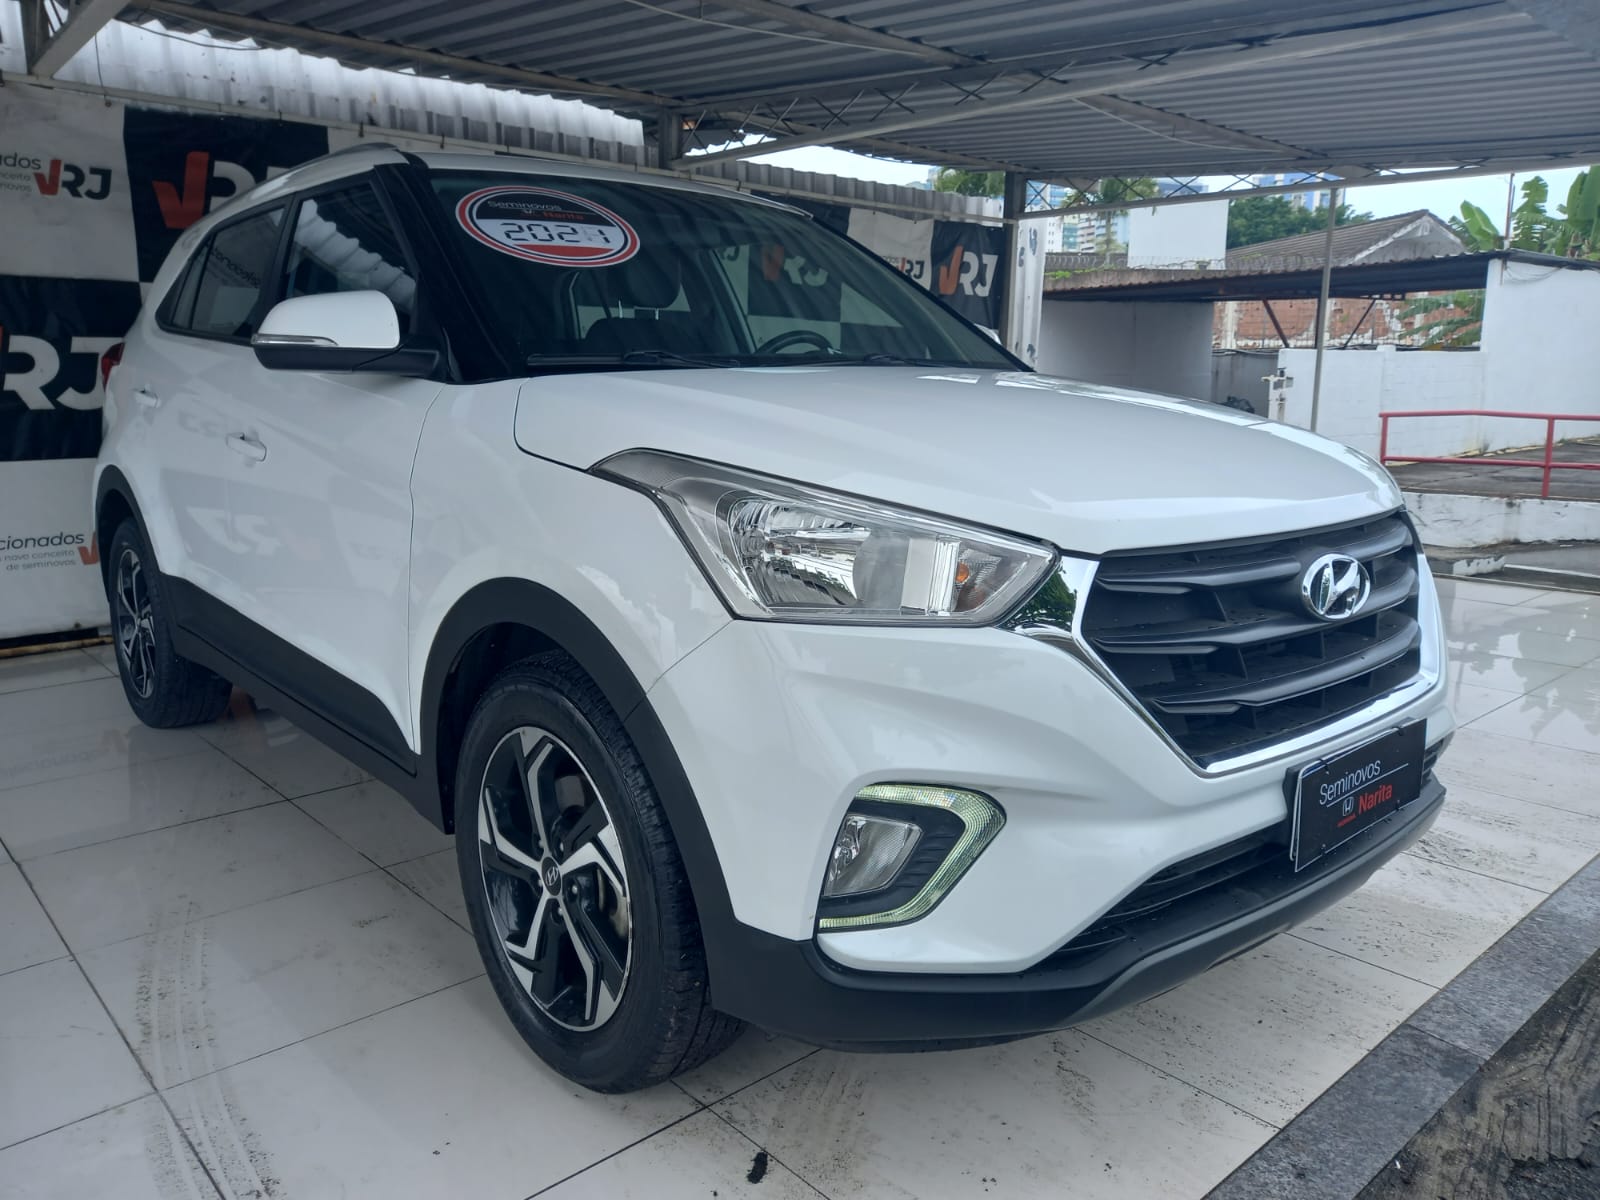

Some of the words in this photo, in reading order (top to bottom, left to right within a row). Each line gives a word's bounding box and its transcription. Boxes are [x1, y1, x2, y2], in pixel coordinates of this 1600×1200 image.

[0, 152, 41, 170] dos
[938, 245, 998, 297] VRJ
[0, 333, 119, 410] RJ
[6, 563, 19, 571] de
[22, 559, 77, 570] seminovos
[31, 550, 75, 560] conceito
[1319, 760, 1381, 805] Seminovos
[1358, 784, 1393, 815] Narita
